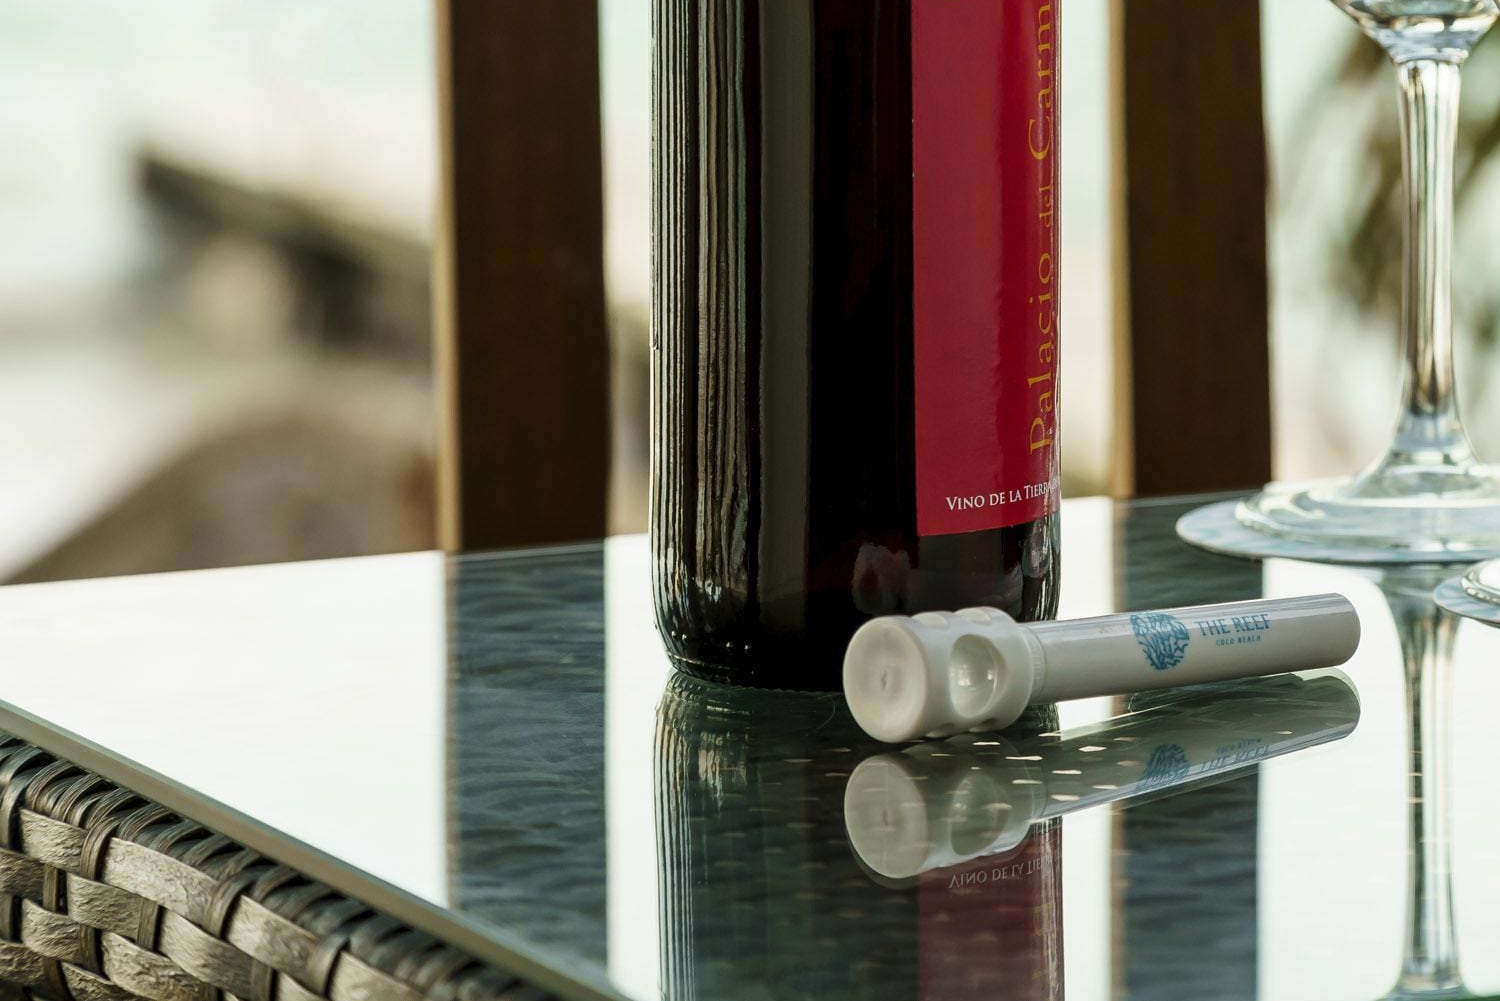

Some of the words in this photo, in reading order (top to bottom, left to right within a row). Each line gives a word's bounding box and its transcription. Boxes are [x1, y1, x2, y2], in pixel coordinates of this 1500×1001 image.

[1027, 252, 1053, 455] Palacio
[946, 495, 985, 511] VINO
[989, 491, 1006, 506] DE
[1009, 489, 1022, 503] LA
[1195, 618, 1231, 637] THE
[1232, 613, 1272, 633] REEF
[1215, 637, 1235, 647] COCO
